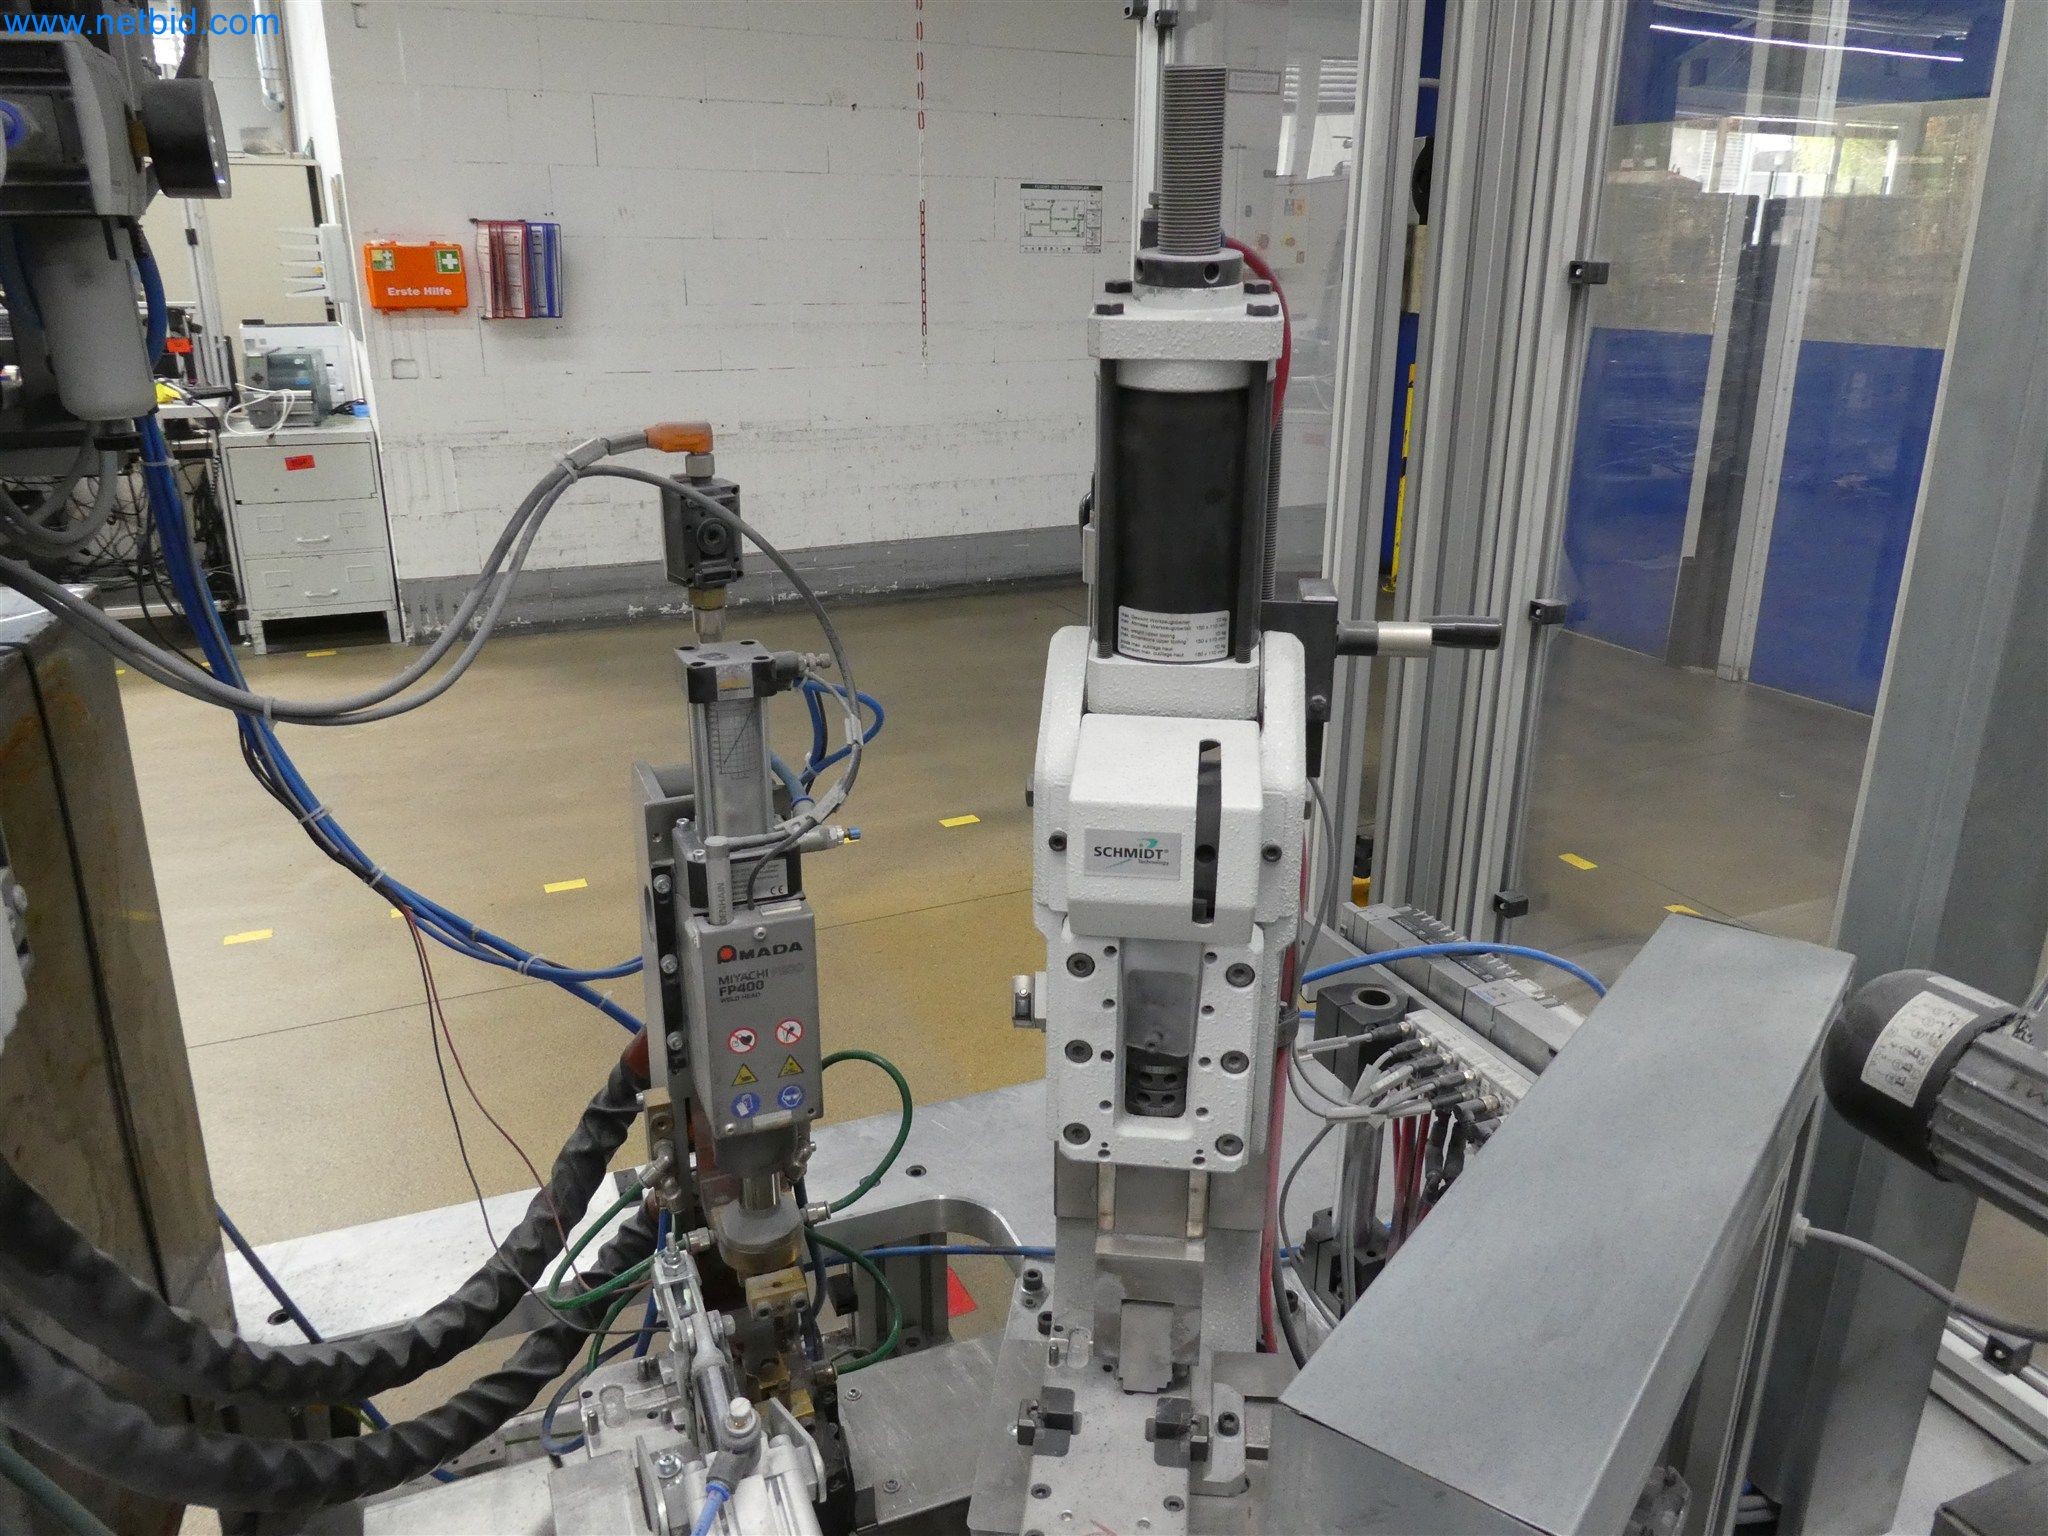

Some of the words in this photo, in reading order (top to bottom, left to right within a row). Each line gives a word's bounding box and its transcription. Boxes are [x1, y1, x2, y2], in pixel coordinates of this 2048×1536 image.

[387, 287, 420, 296] Erste
[423, 287, 453, 296] Hilfe
[718, 969, 769, 985] MIYACHI
[719, 980, 765, 997] FP400
